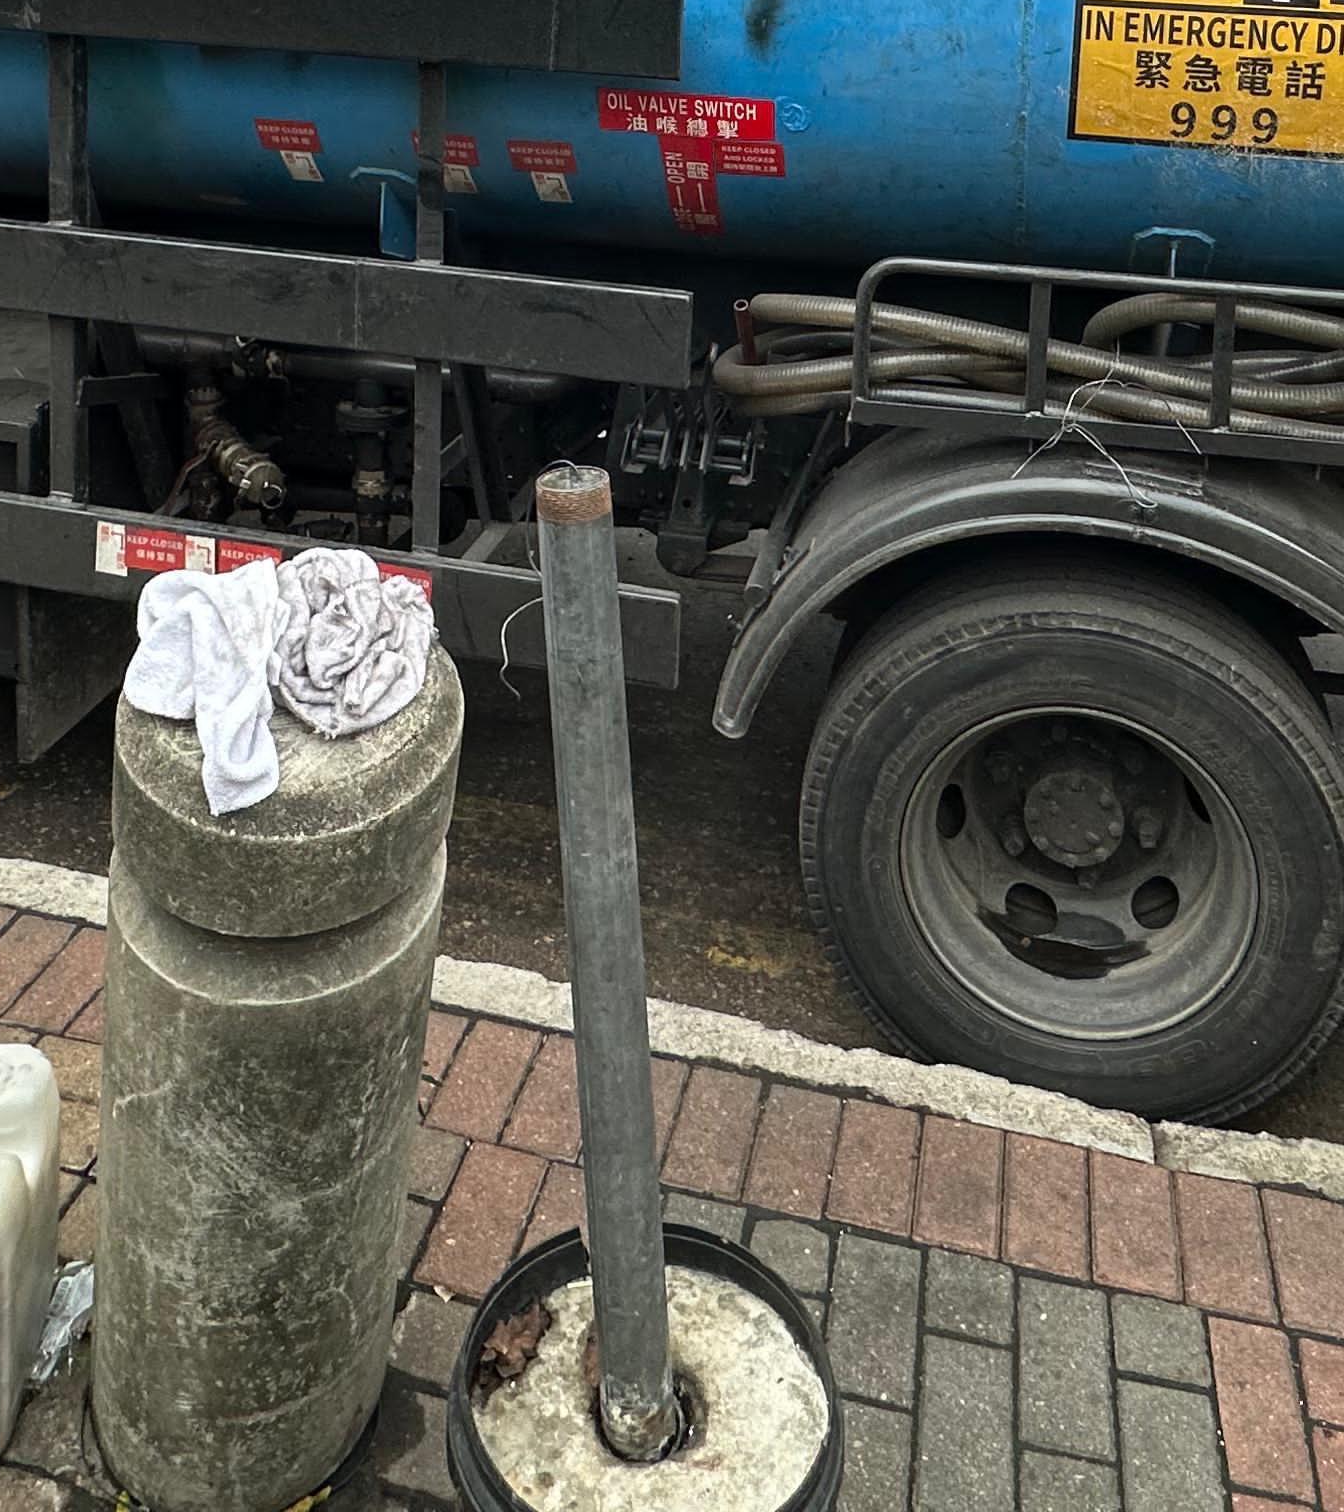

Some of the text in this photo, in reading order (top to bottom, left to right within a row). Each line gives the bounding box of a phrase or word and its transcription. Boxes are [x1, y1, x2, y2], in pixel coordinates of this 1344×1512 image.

[1085, 9, 1115, 41] IN
[1124, 12, 1309, 53] EMERGENCY
[1135, 50, 1326, 101] 緊急電話
[607, 92, 757, 121] OIL VALVE SWITCH
[664, 151, 686, 184] OPEN
